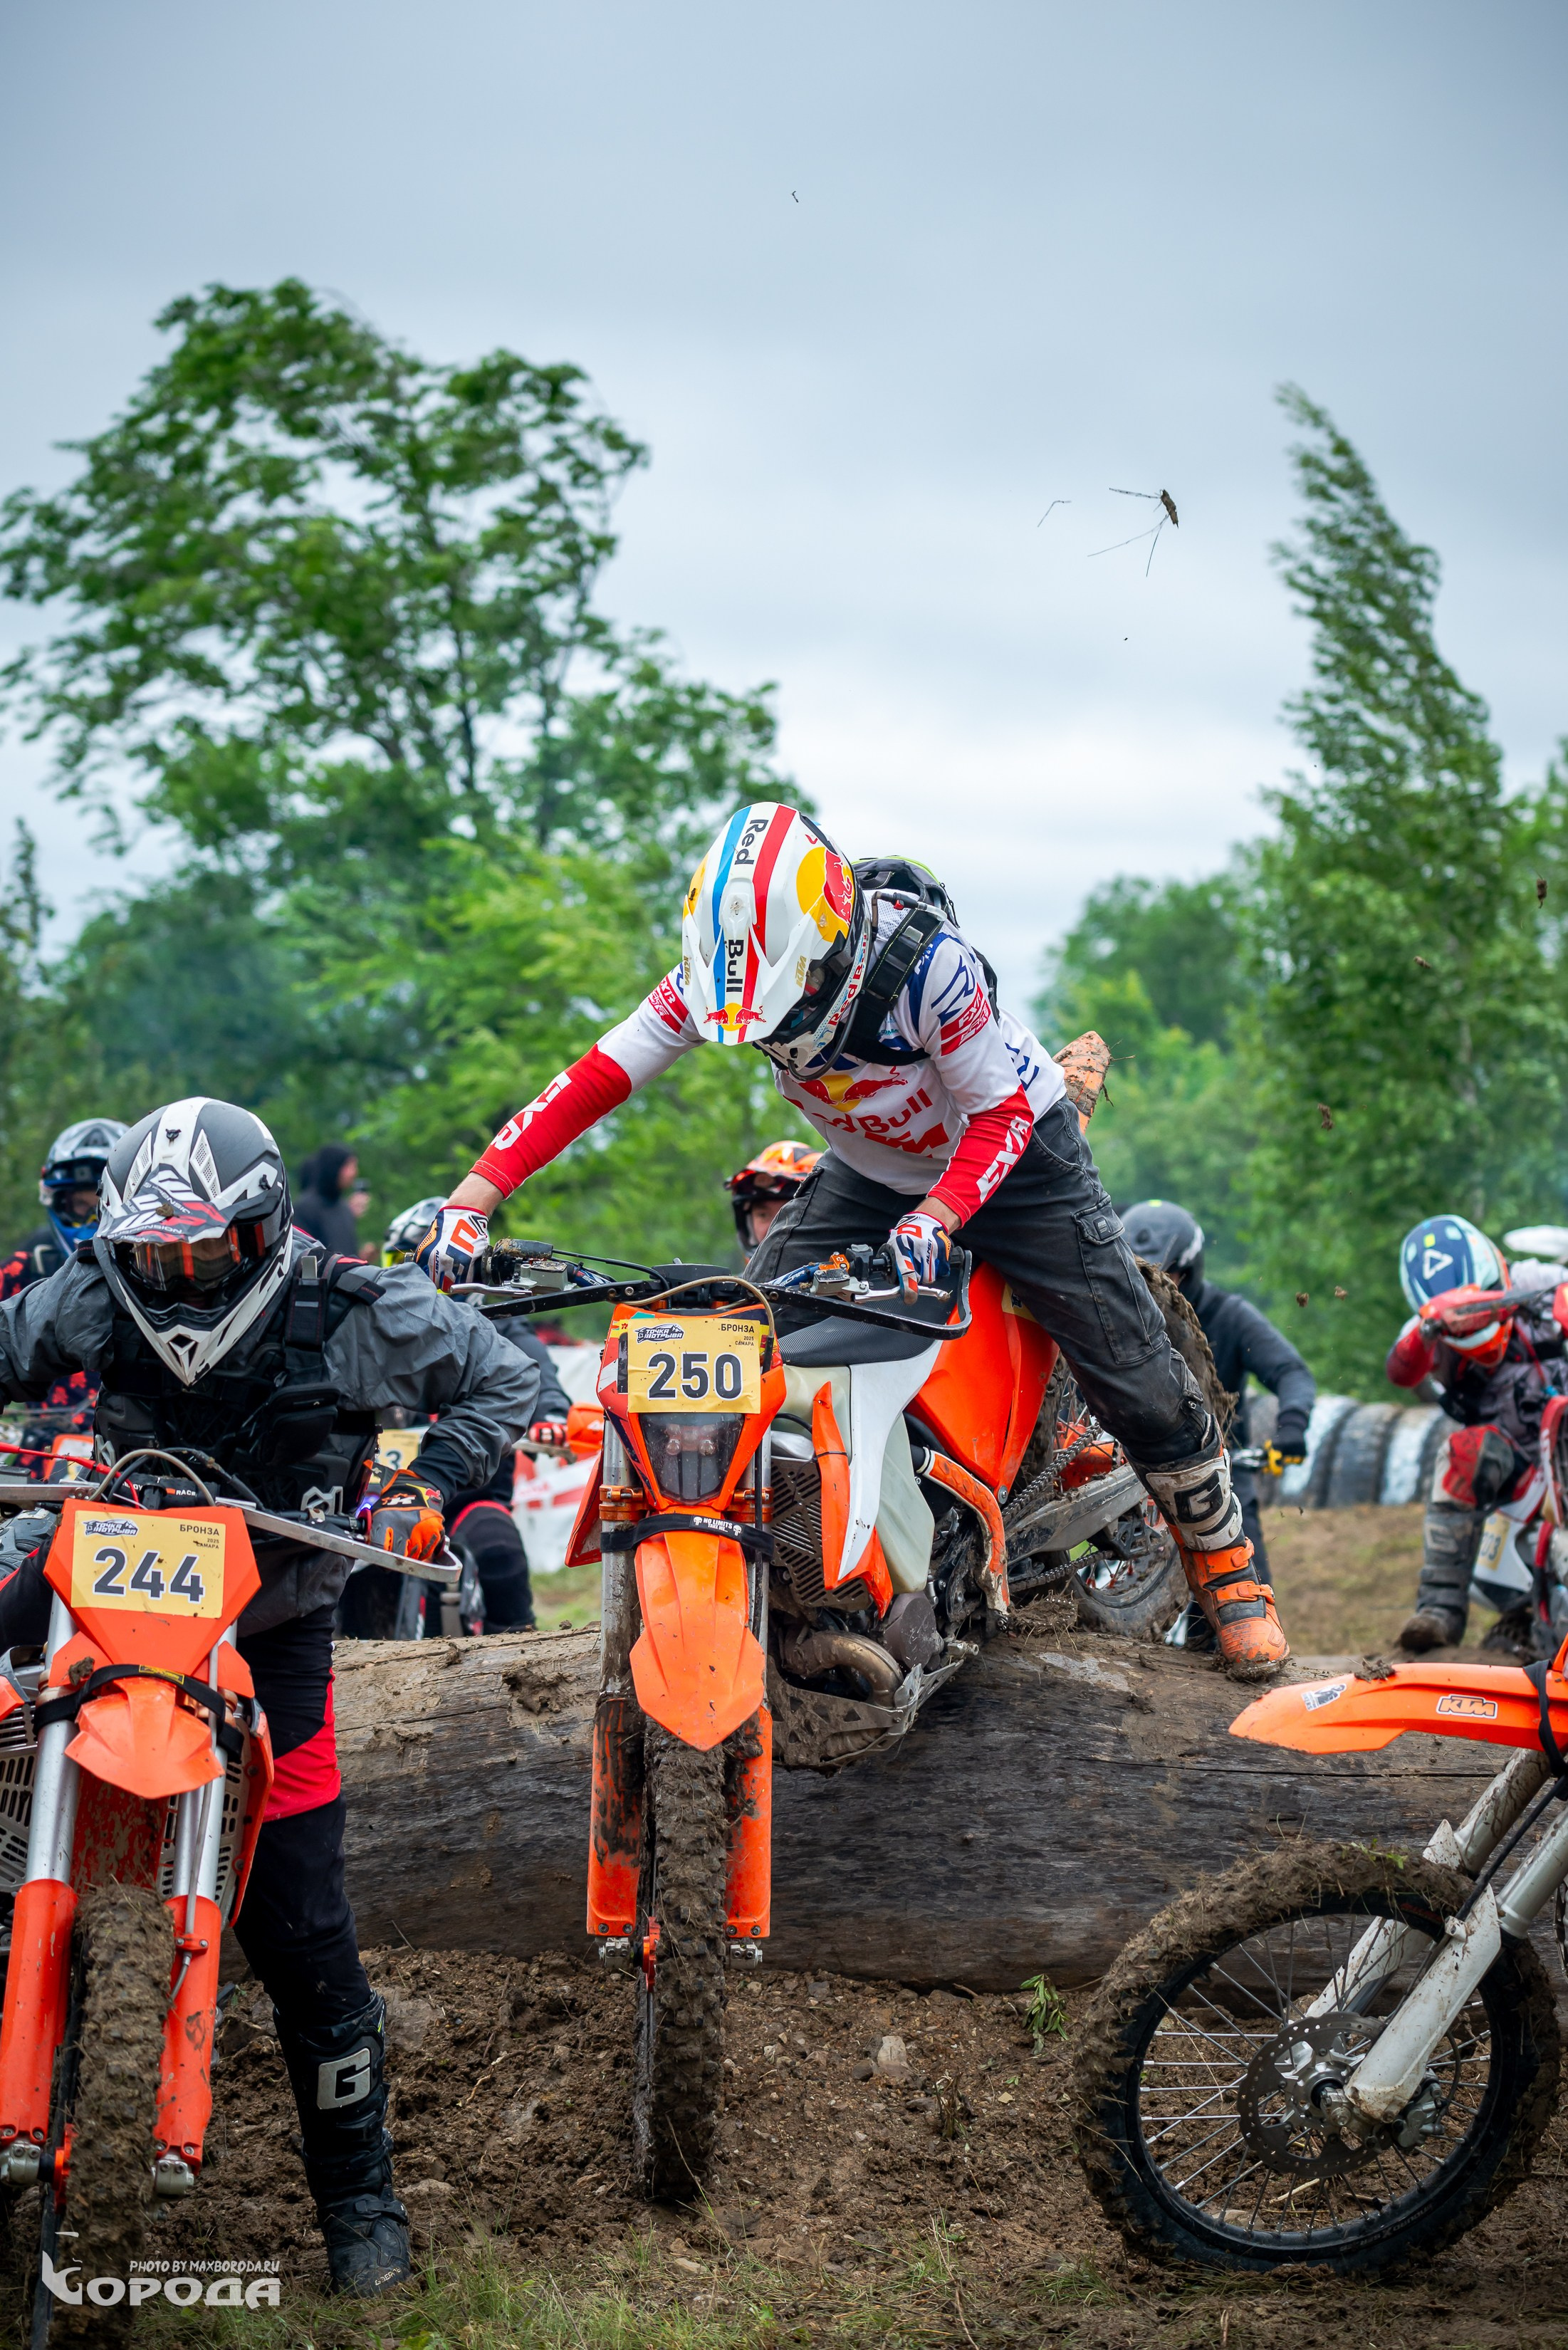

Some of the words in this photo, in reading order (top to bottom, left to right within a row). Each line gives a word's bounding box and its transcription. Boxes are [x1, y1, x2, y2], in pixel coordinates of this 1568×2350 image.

[734, 819, 769, 865] Red
[726, 939, 744, 993] Bull
[795, 955, 807, 988] KTM
[827, 984, 858, 1026] Red
[490, 1071, 573, 1151] FXR
[856, 1087, 934, 1134] Bull
[721, 1323, 755, 1333] БРОНЗА
[647, 1352, 742, 1400] 250
[179, 1524, 219, 1536] БРОНЗА
[712, 1519, 733, 1529] LIMITS
[94, 1548, 204, 1602] 244
[1438, 1695, 1496, 1717] KTM
